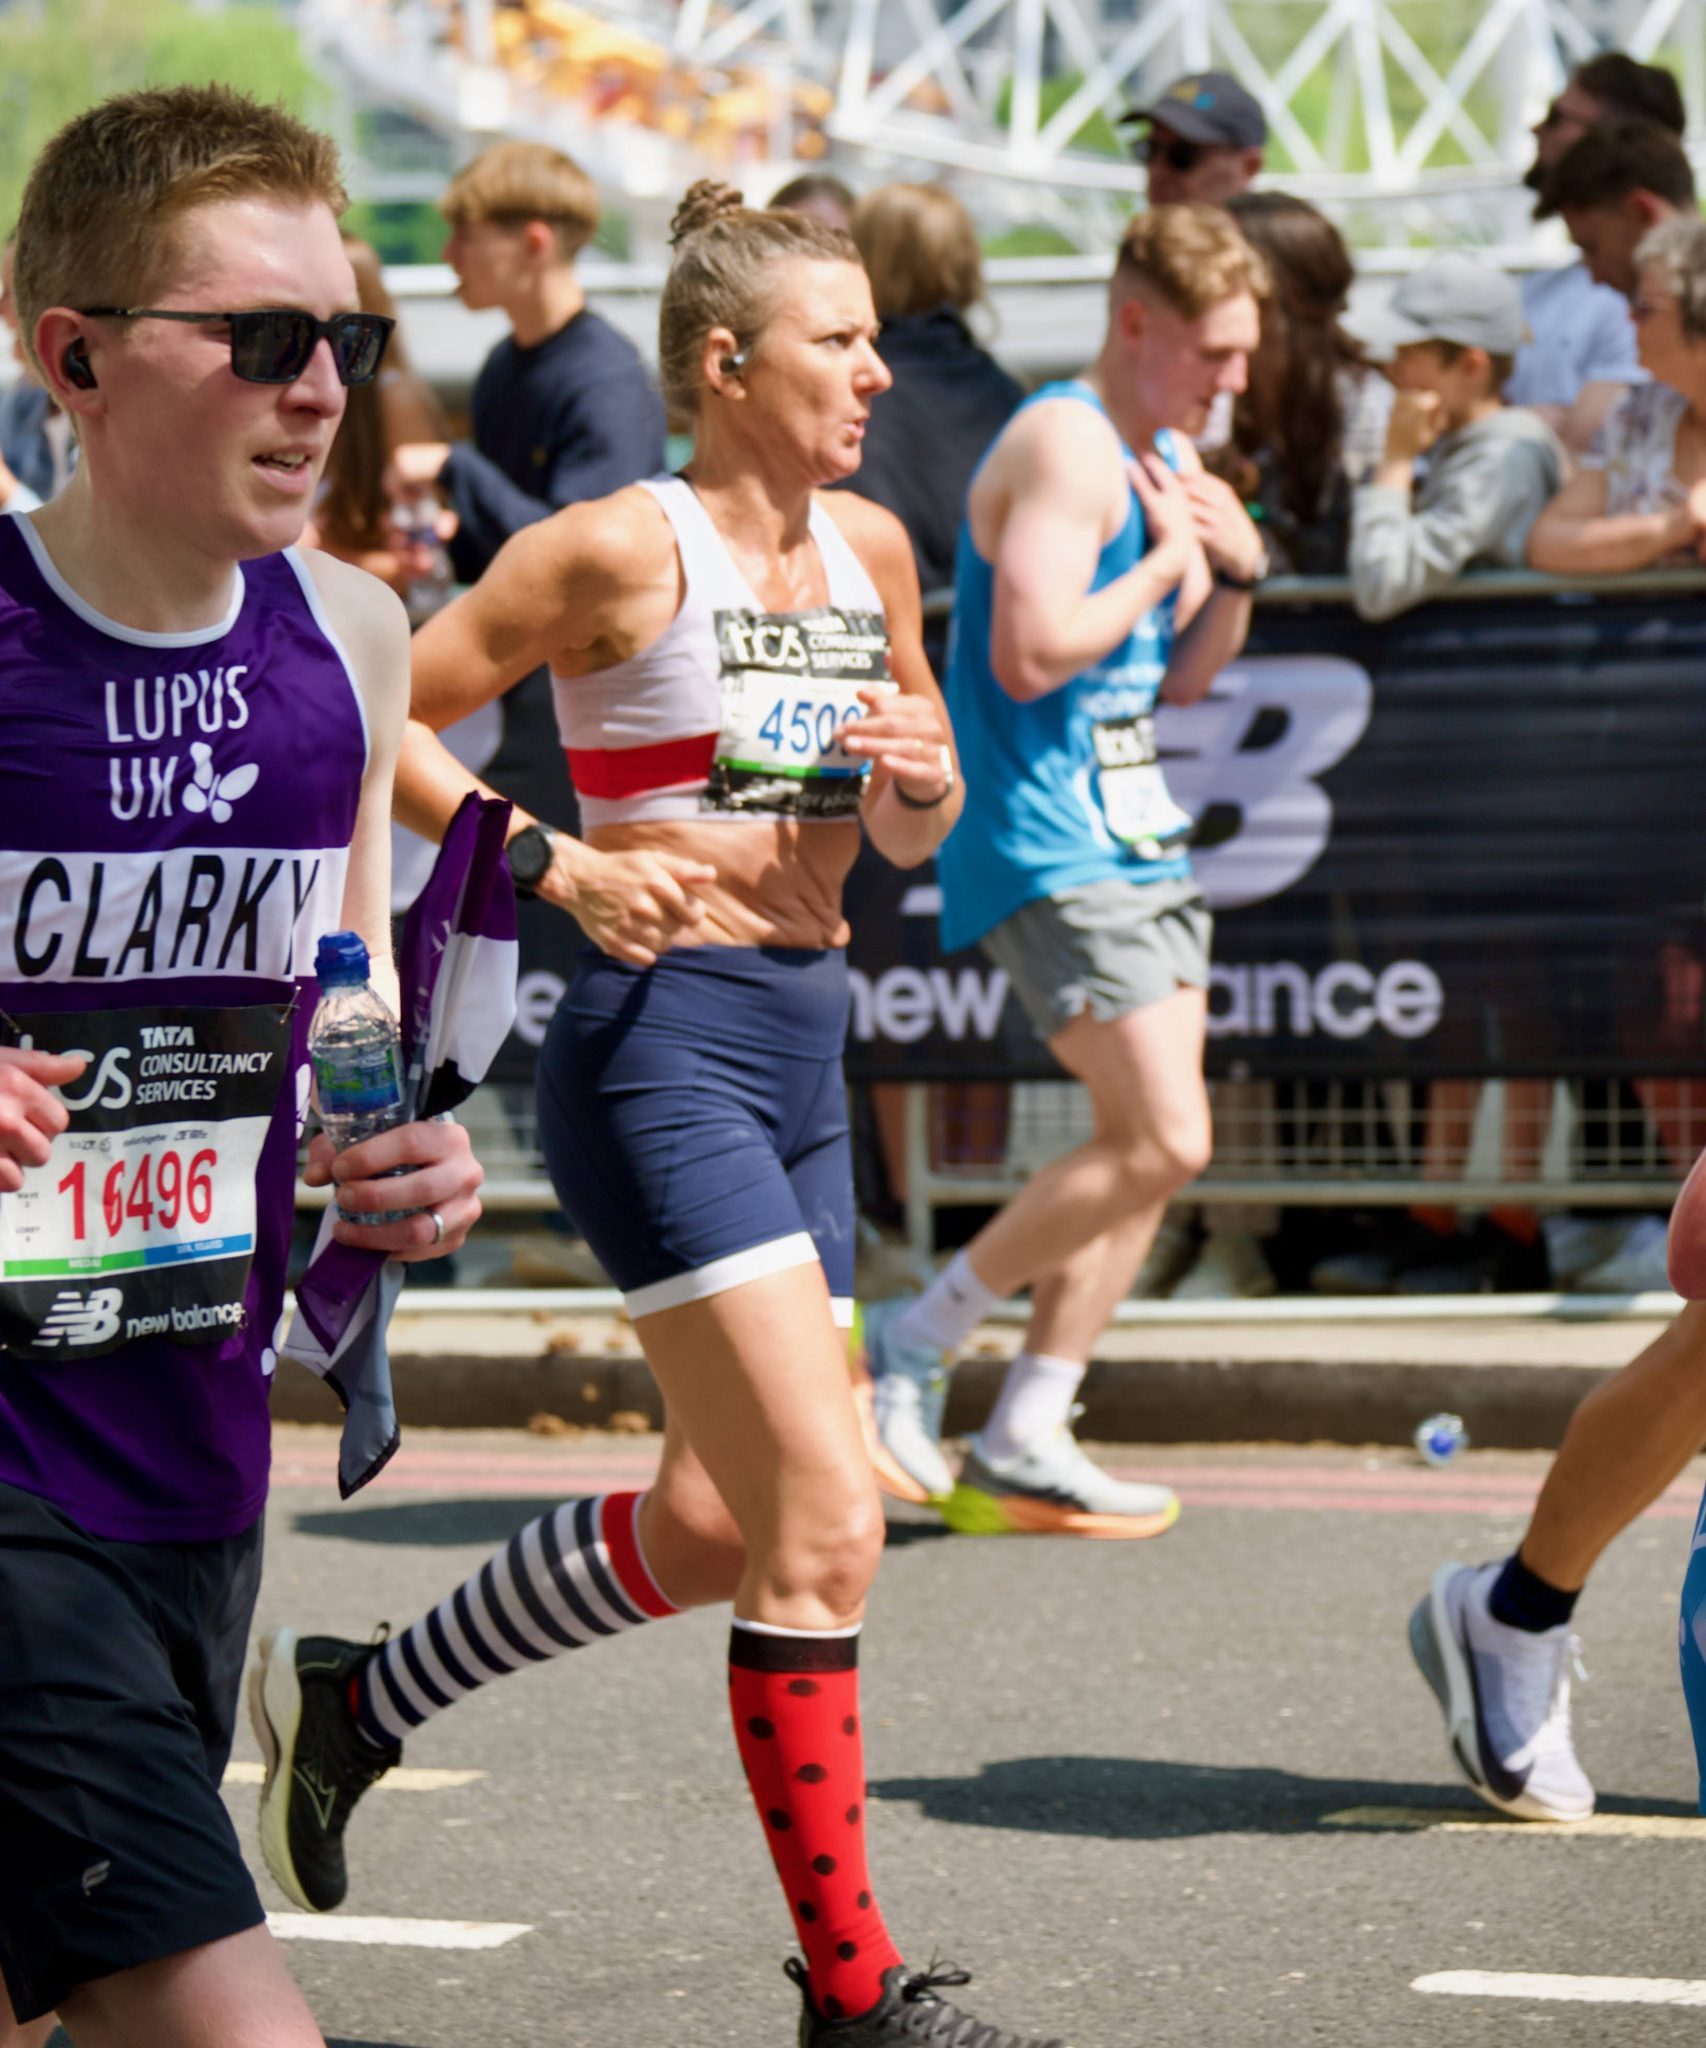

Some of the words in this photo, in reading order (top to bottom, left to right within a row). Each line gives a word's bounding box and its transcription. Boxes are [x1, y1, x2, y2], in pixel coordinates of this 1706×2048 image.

[104, 665, 250, 743] LUPUS
[109, 755, 179, 821] UK
[14, 854, 321, 978] CLARKY
[847, 965, 1009, 1043] new
[1207, 960, 1444, 1038] ance
[140, 1026, 195, 1049] TATA
[140, 1052, 273, 1077] CONSULTANCY
[135, 1079, 217, 1105] SERVICES
[58, 1148, 218, 1240] 16496
[126, 1312, 170, 1338] new
[171, 1301, 243, 1332] balance
